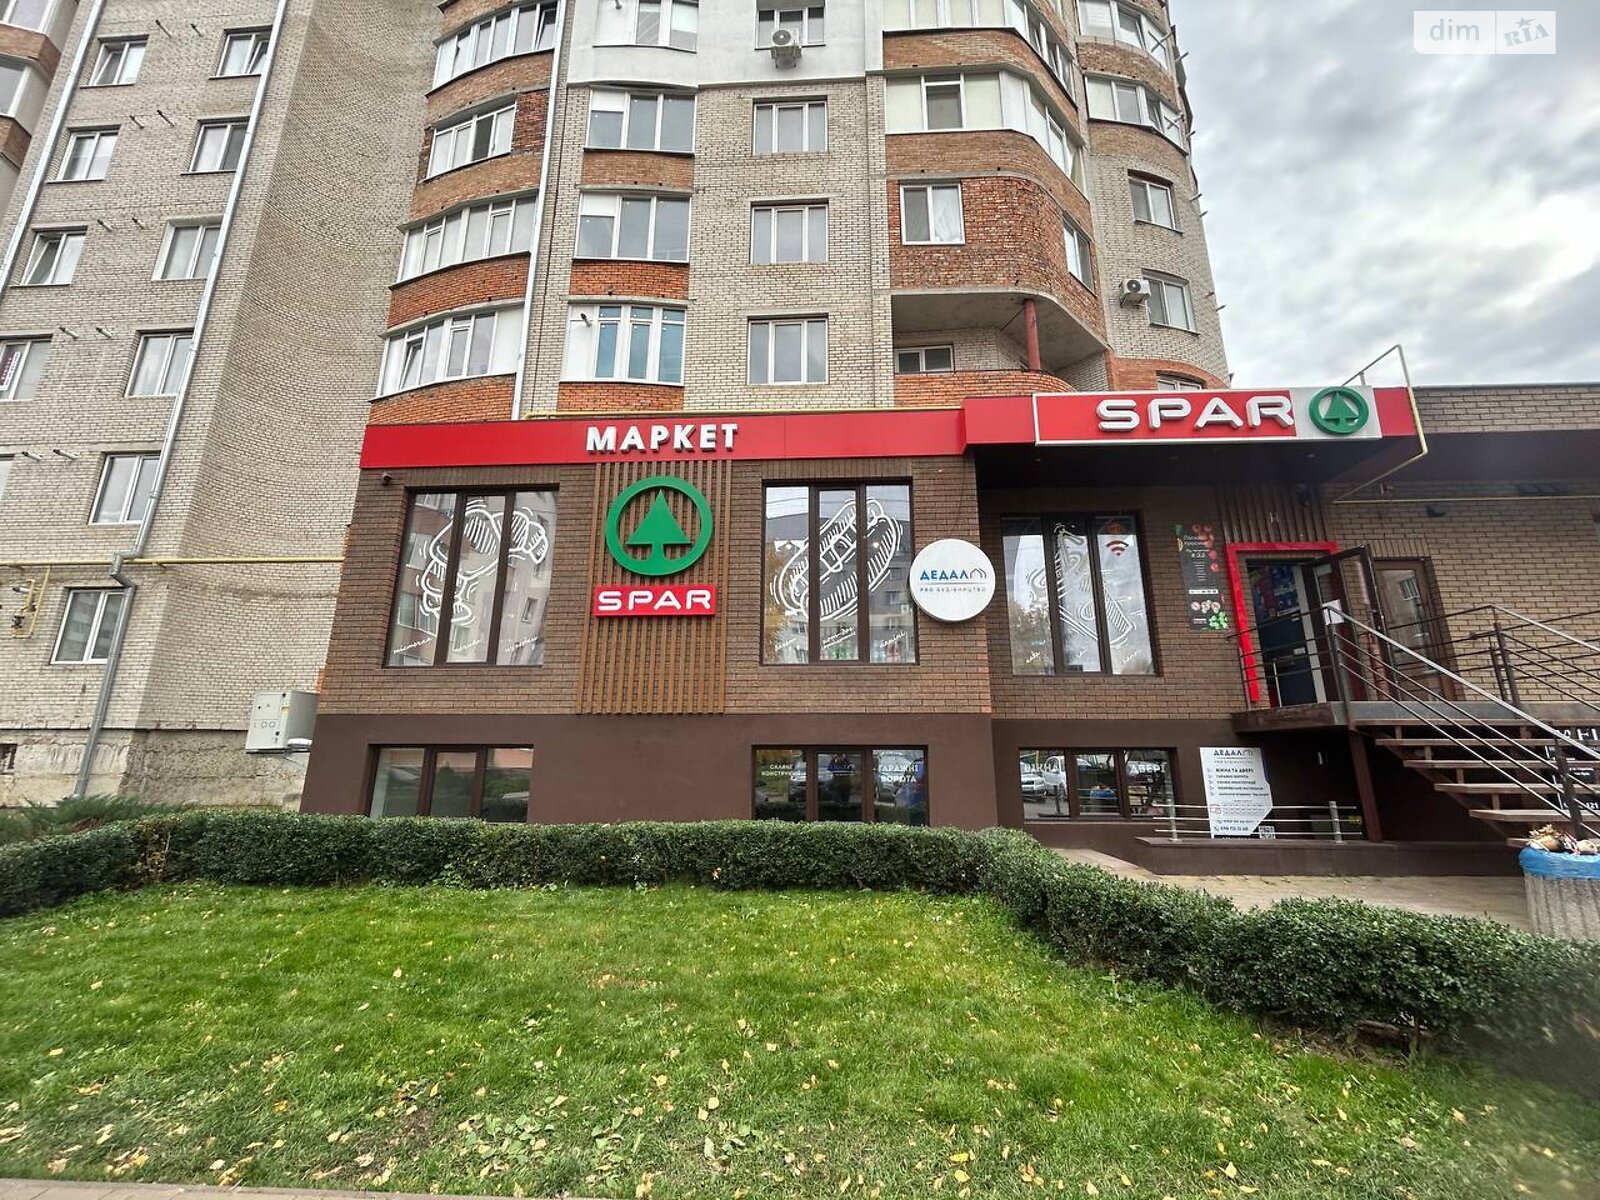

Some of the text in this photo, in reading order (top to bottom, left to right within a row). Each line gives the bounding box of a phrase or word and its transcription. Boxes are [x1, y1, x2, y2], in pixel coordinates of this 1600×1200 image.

[1097, 396, 1295, 431] SPAR
[586, 423, 738, 453] МАРКЕТ
[920, 569, 969, 581] ДЕДАЛ
[598, 589, 712, 611] SPAR
